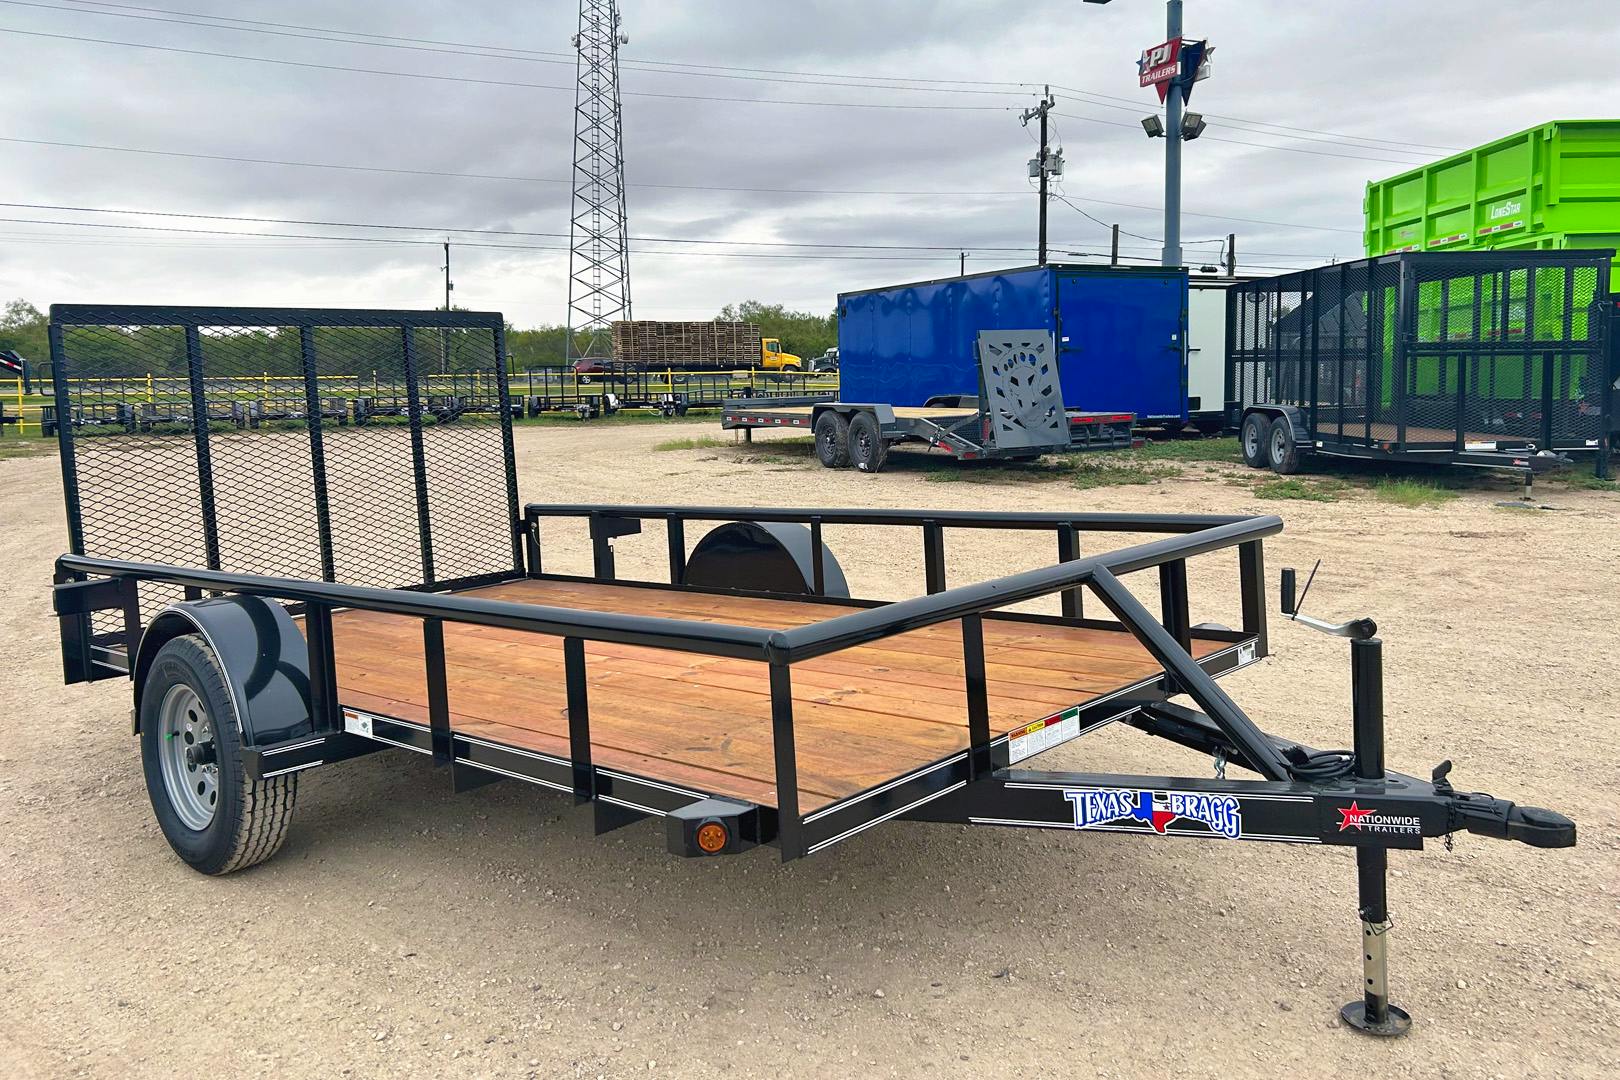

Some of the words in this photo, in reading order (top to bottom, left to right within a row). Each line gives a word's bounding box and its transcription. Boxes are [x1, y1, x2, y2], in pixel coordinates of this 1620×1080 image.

[1149, 44, 1172, 67] PJ
[1141, 65, 1176, 83] TRAILERS
[1065, 790, 1133, 828] TEXAS
[1171, 793, 1240, 838] BRAGG
[1349, 814, 1420, 826] NATIONWIDE
[1368, 826, 1420, 835] TRAILERS
